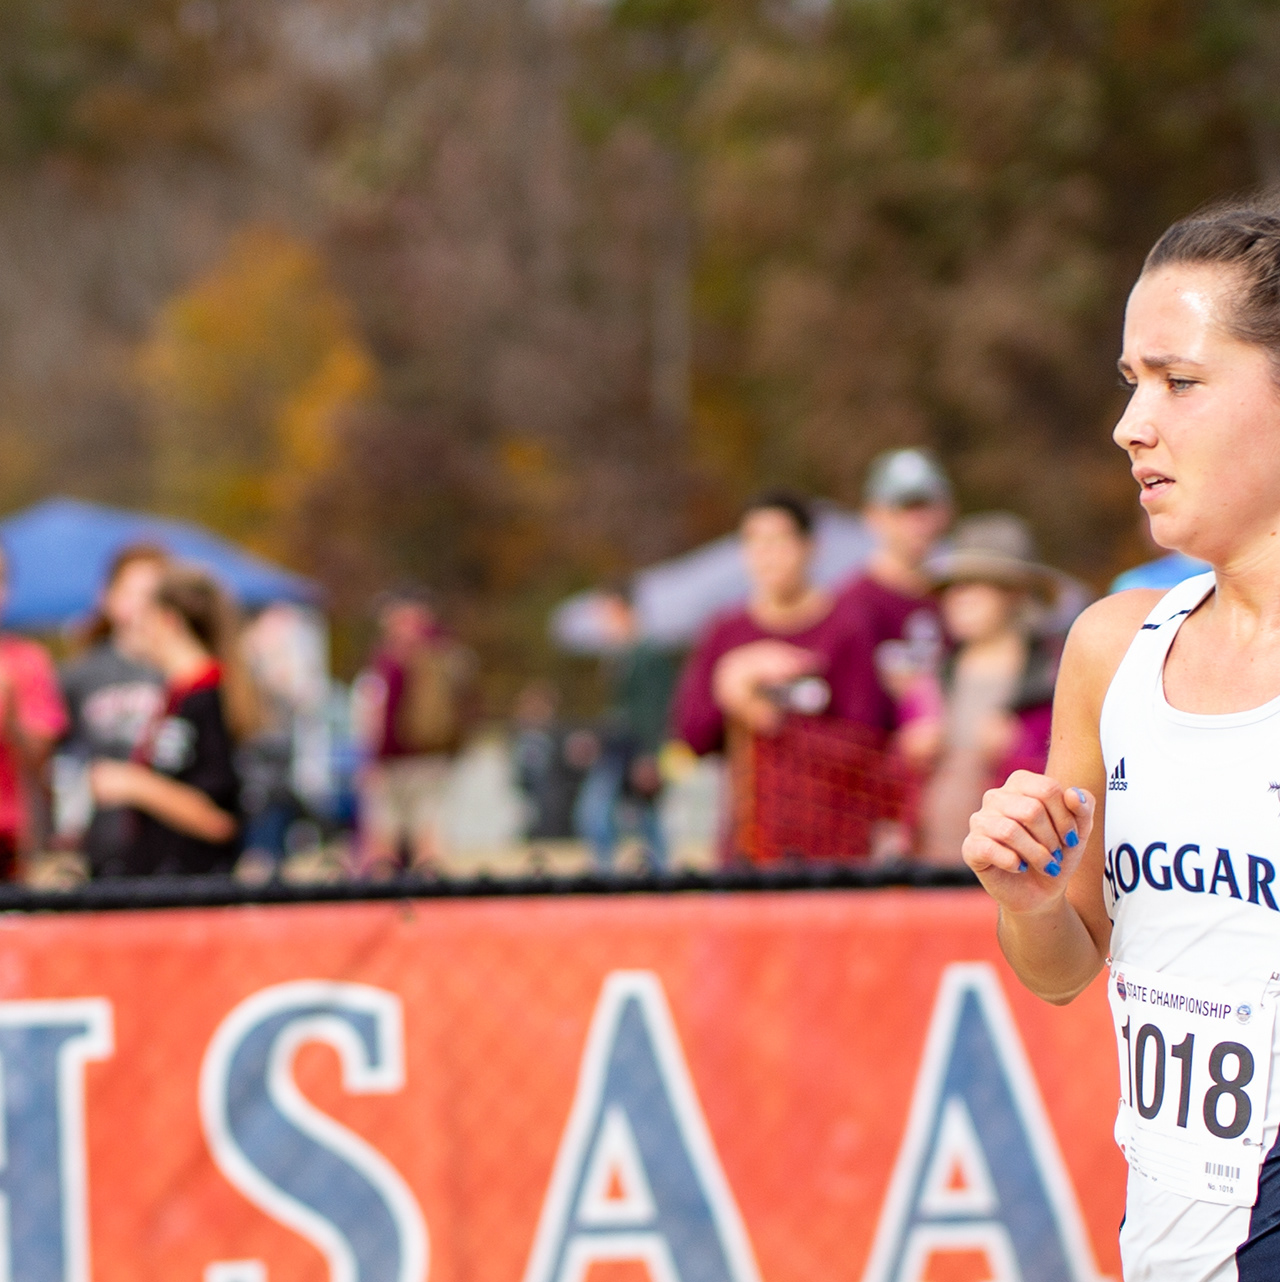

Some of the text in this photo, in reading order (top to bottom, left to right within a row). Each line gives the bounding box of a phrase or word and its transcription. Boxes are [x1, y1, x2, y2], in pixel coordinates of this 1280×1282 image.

[1126, 982, 1232, 1020] STATE CHAMPIONSHIP
[1121, 1014, 1255, 1139] 1018
